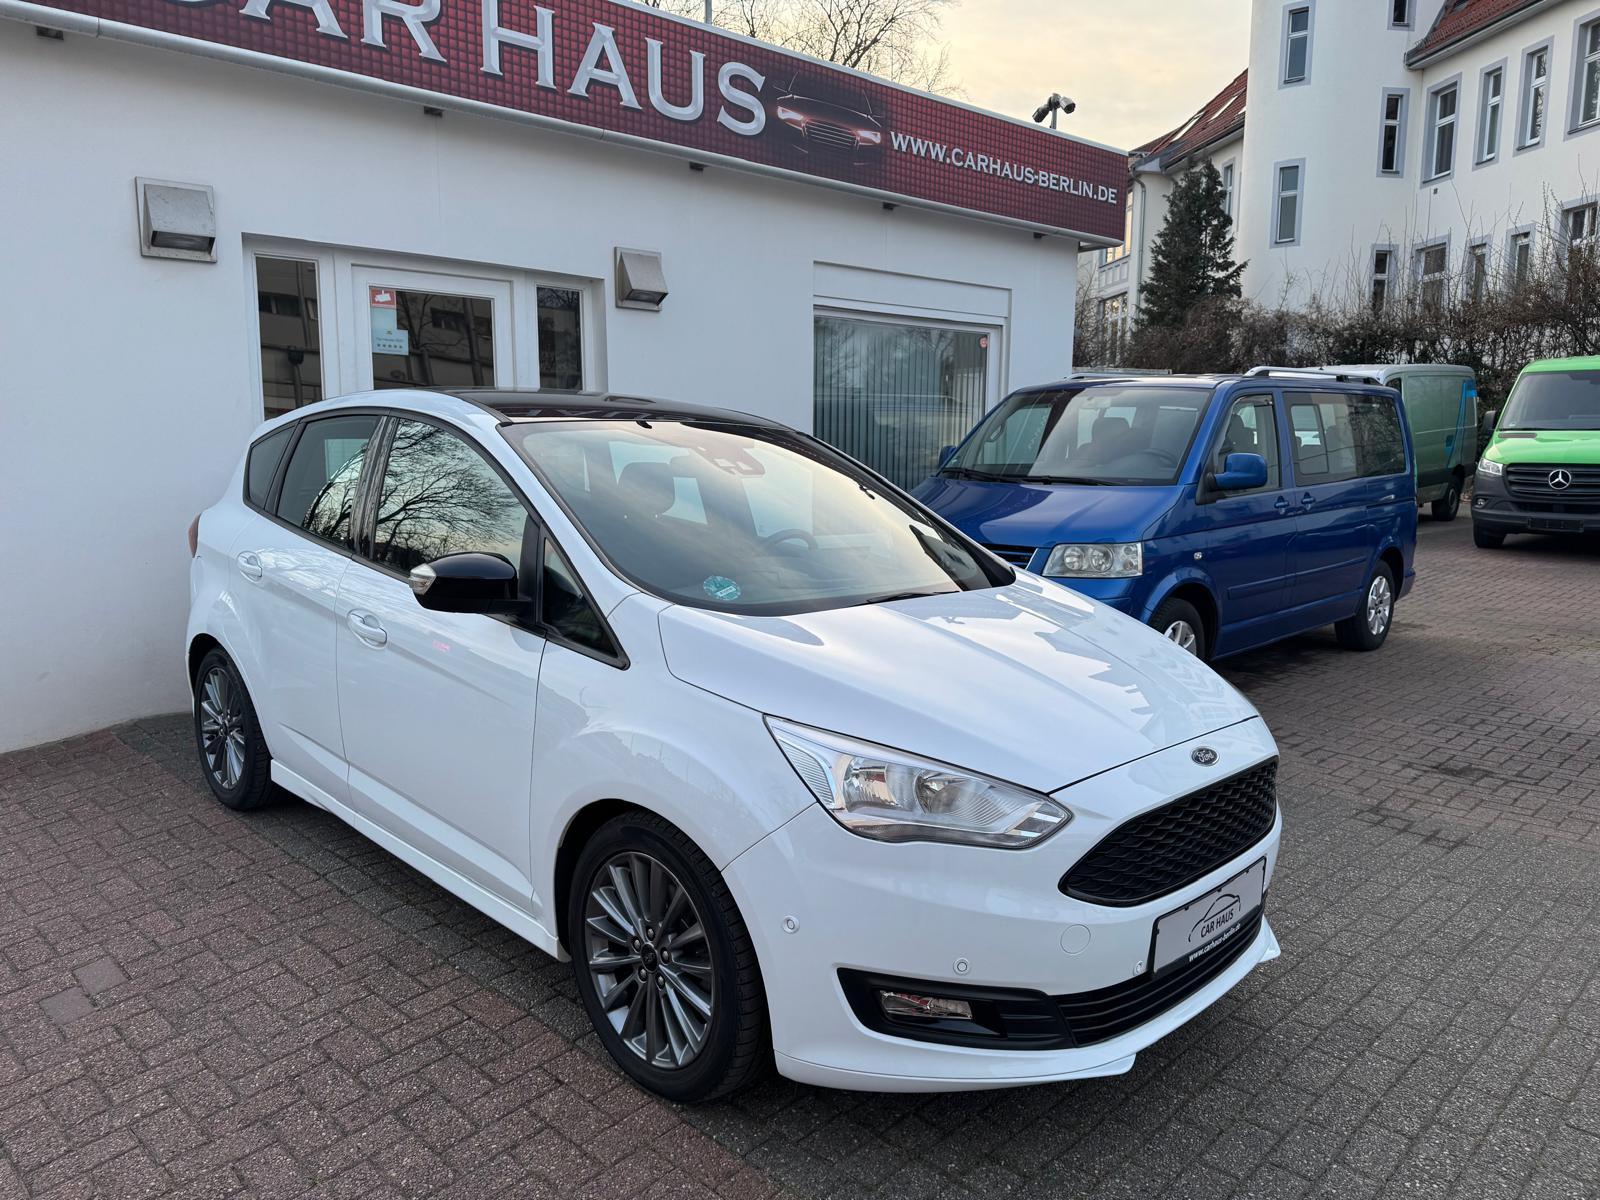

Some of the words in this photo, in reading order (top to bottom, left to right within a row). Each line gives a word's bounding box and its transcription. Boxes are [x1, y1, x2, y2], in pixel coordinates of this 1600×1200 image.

[480, 0, 768, 137] HAUS
[889, 131, 1118, 204] WWW.CARHAUS-BERLIN.DE
[1200, 920, 1215, 938] CAR
[1216, 908, 1234, 929] HAUS
